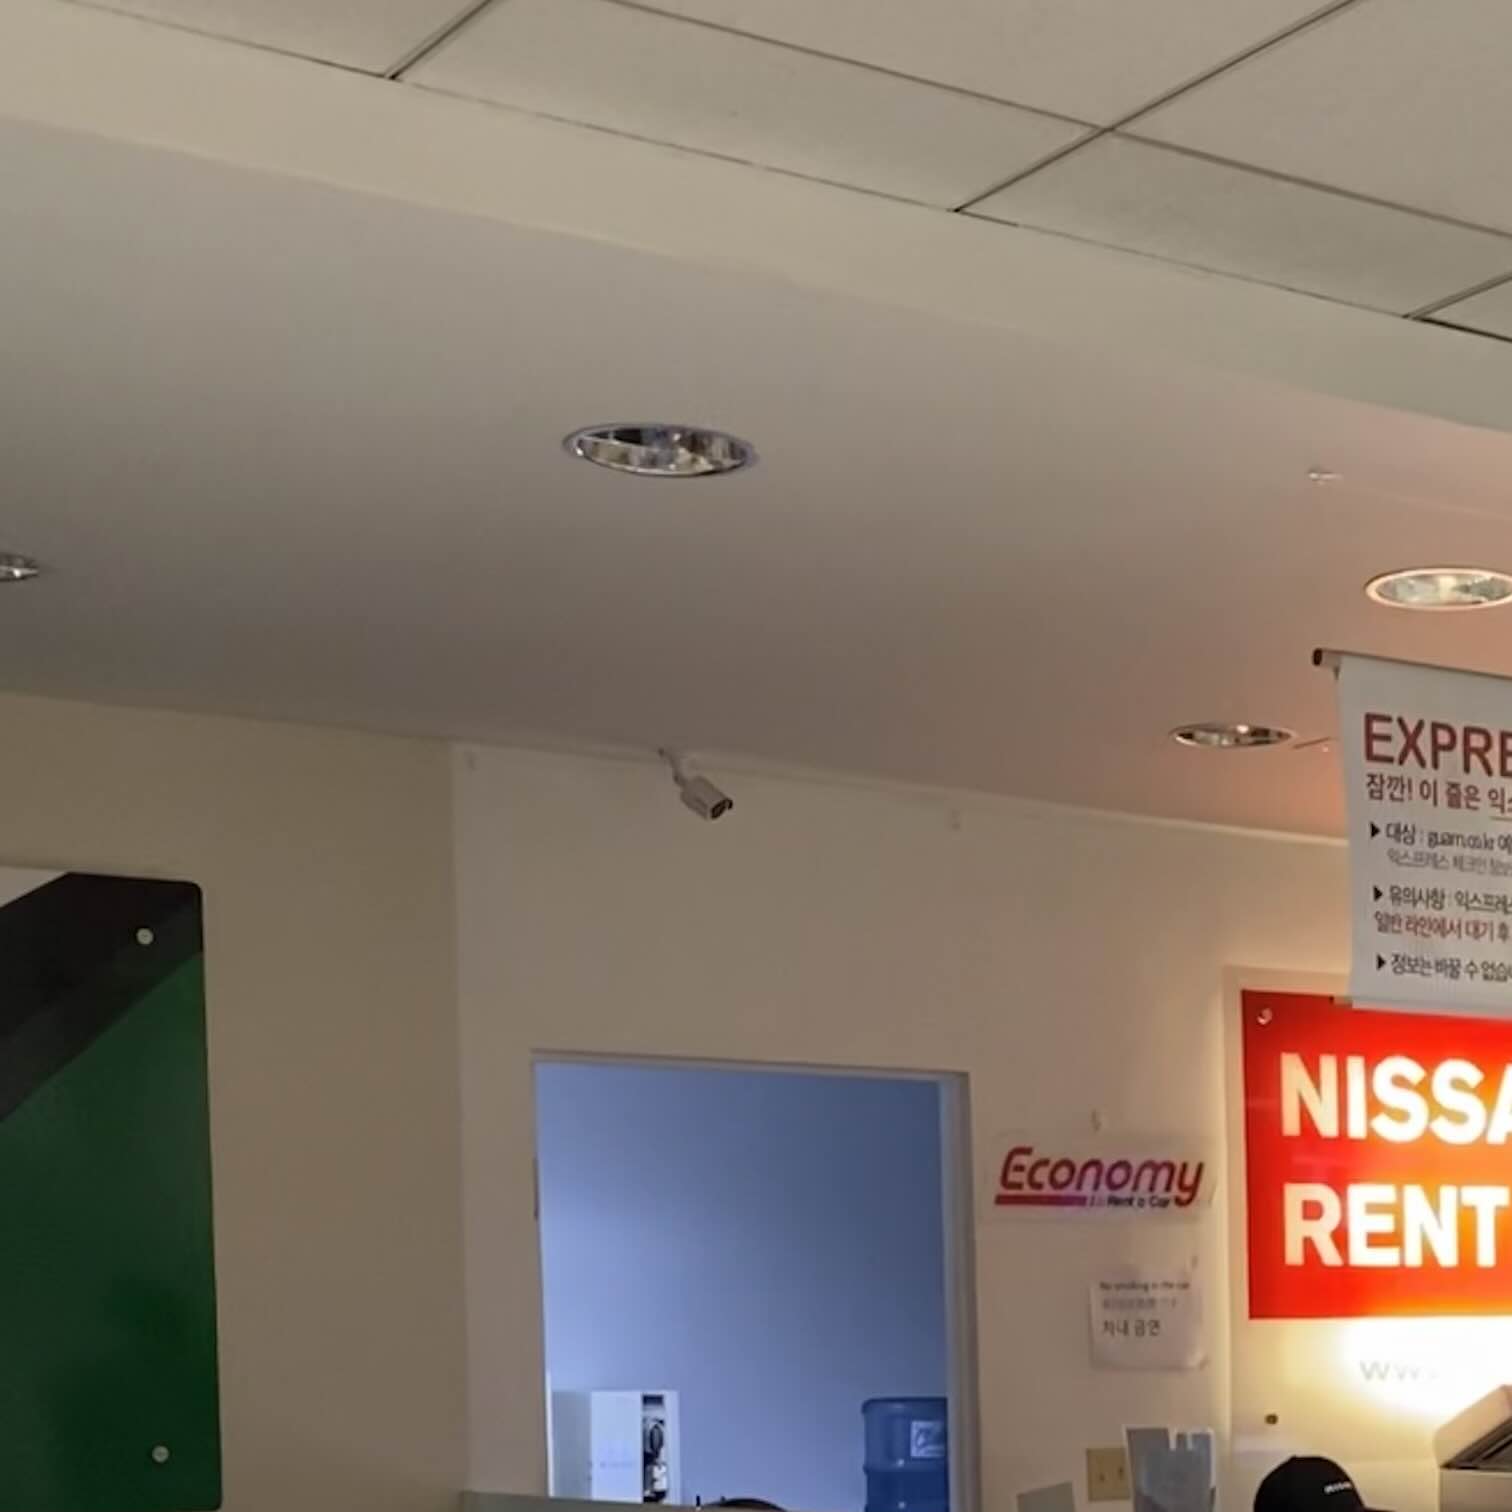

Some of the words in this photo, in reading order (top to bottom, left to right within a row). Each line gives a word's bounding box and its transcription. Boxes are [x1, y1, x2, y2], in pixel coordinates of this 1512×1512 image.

[1366, 772, 1413, 802] 잠깐!
[1419, 779, 1438, 807] 이
[1446, 781, 1480, 811] 줄은
[1386, 822, 1416, 846] 대상
[1389, 885, 1446, 911] 유의사항
[1374, 910, 1403, 933] 일반
[1405, 915, 1462, 940] 라인에서
[1465, 920, 1495, 943] 대기
[1498, 922, 1509, 943] 후
[1391, 953, 1432, 978] 정보는
[1464, 960, 1479, 981] 수
[1000, 1146, 1205, 1208] Economy
[1107, 1194, 1134, 1207] Rent
[1149, 1195, 1171, 1208] Car
[1283, 1182, 1510, 1268] RENT
